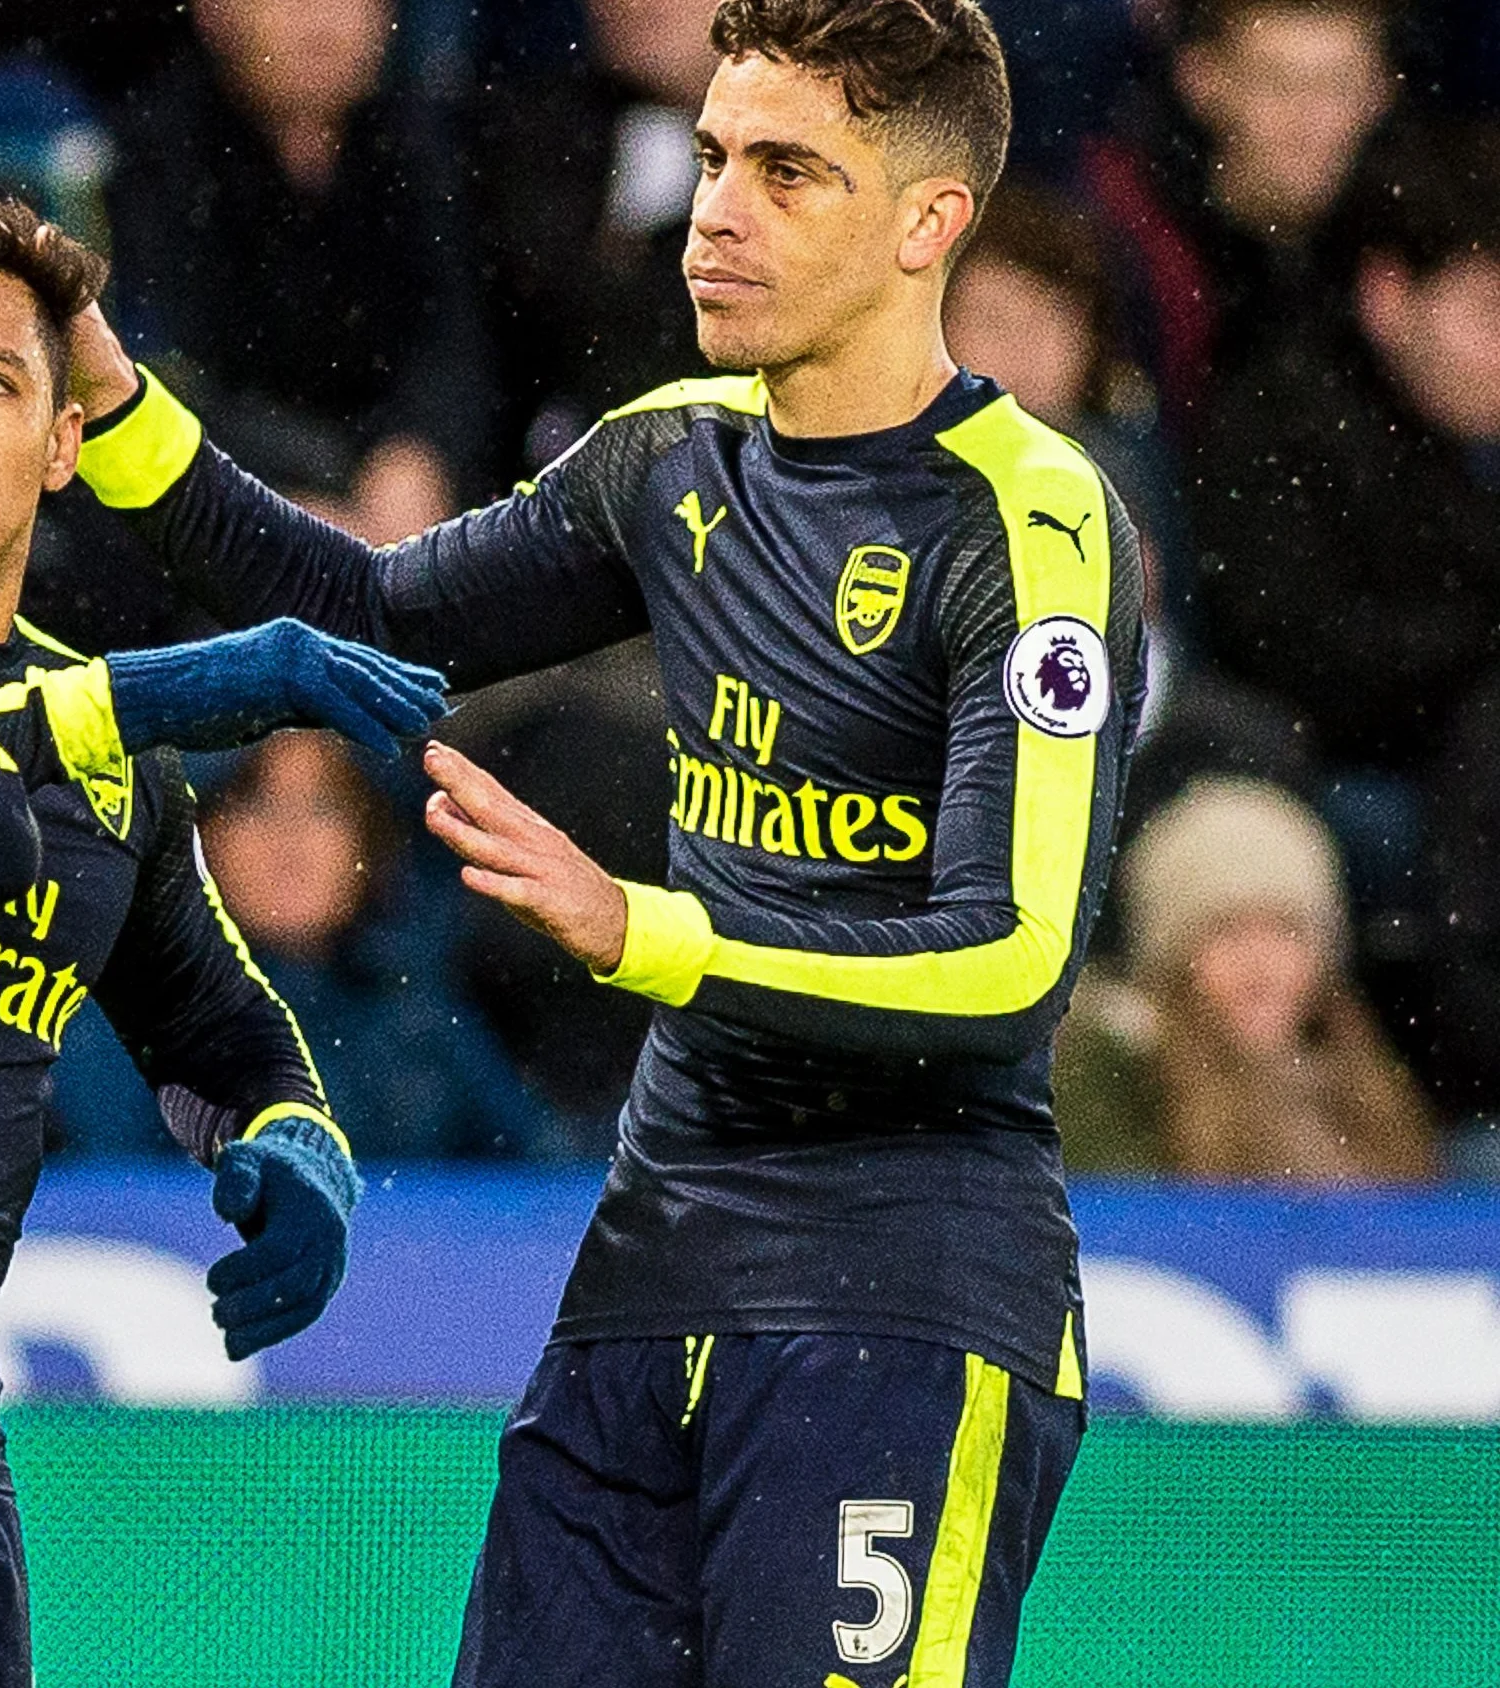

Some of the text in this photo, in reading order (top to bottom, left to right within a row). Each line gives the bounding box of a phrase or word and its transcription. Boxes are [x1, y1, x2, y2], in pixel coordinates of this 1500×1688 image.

[708, 673, 781, 766] Fly
[666, 728, 928, 862] mirates
[832, 1500, 914, 1664] 5
